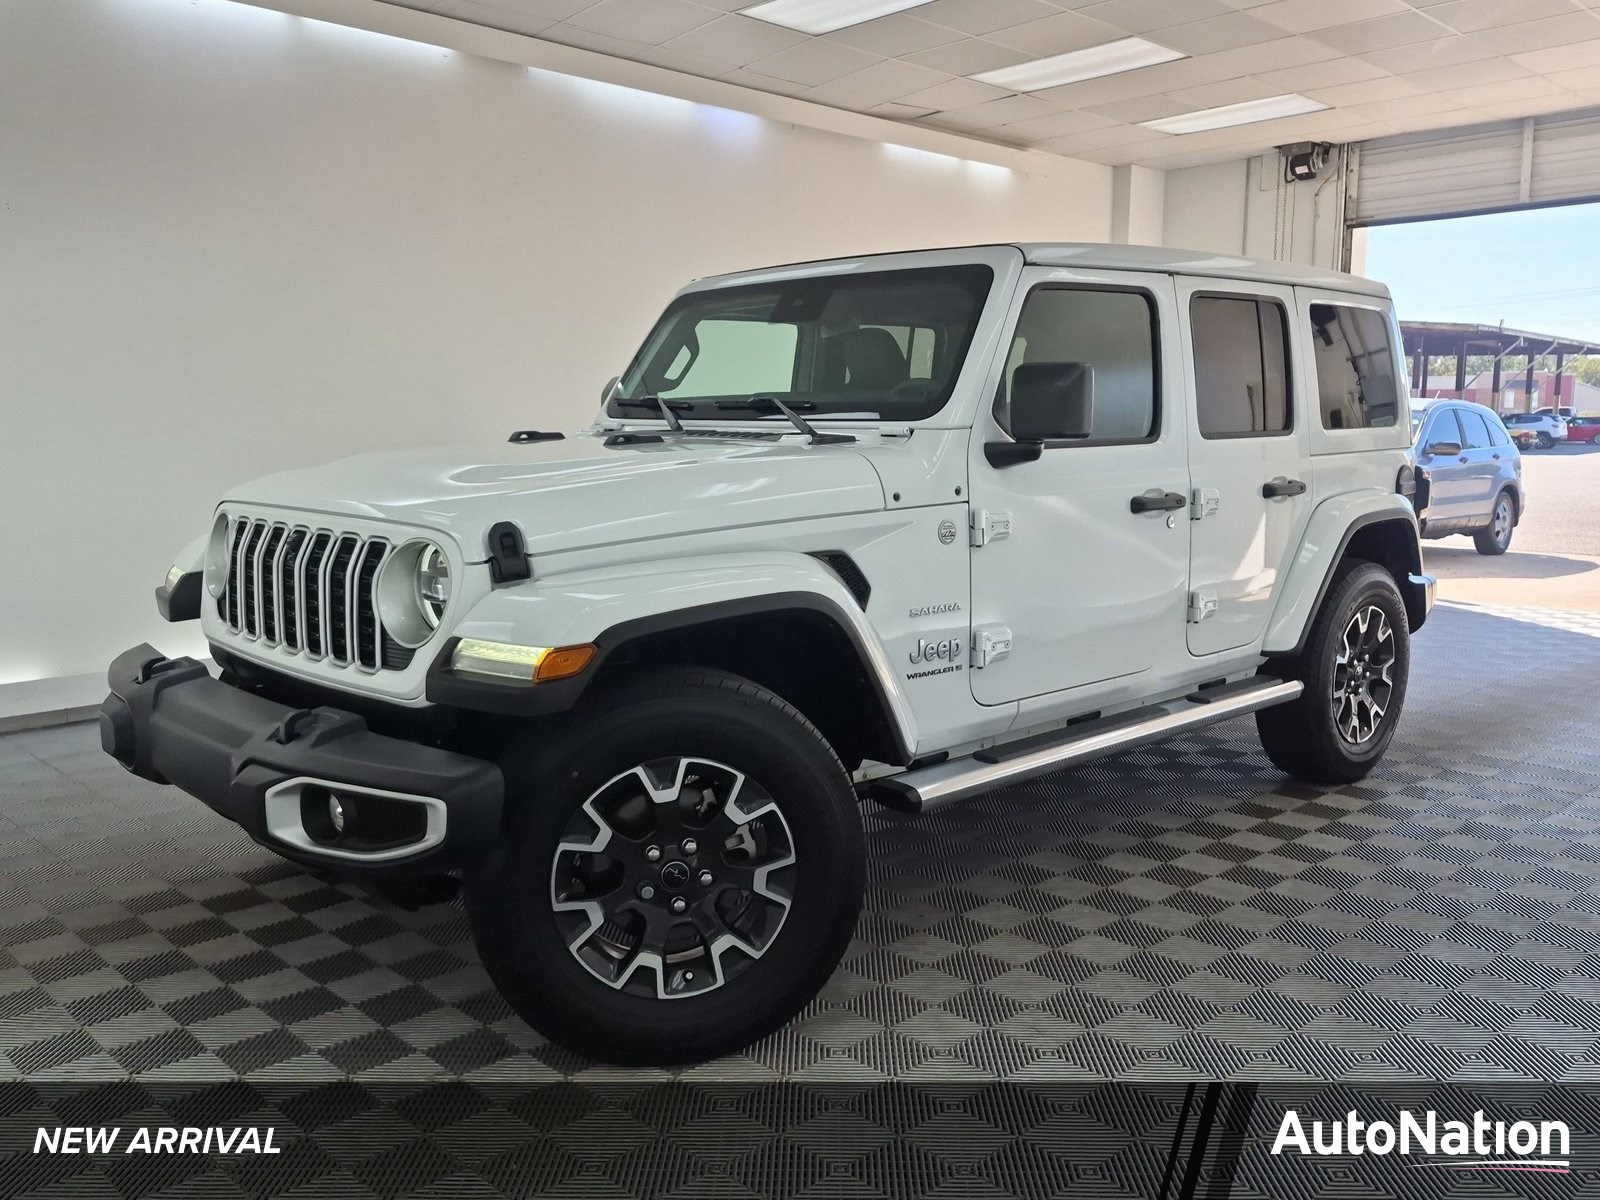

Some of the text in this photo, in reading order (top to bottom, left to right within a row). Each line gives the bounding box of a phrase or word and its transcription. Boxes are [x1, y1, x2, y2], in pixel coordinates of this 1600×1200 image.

[909, 602, 962, 618] SAHARA
[909, 638, 962, 664] Jeep
[906, 666, 954, 680] WRANGLER
